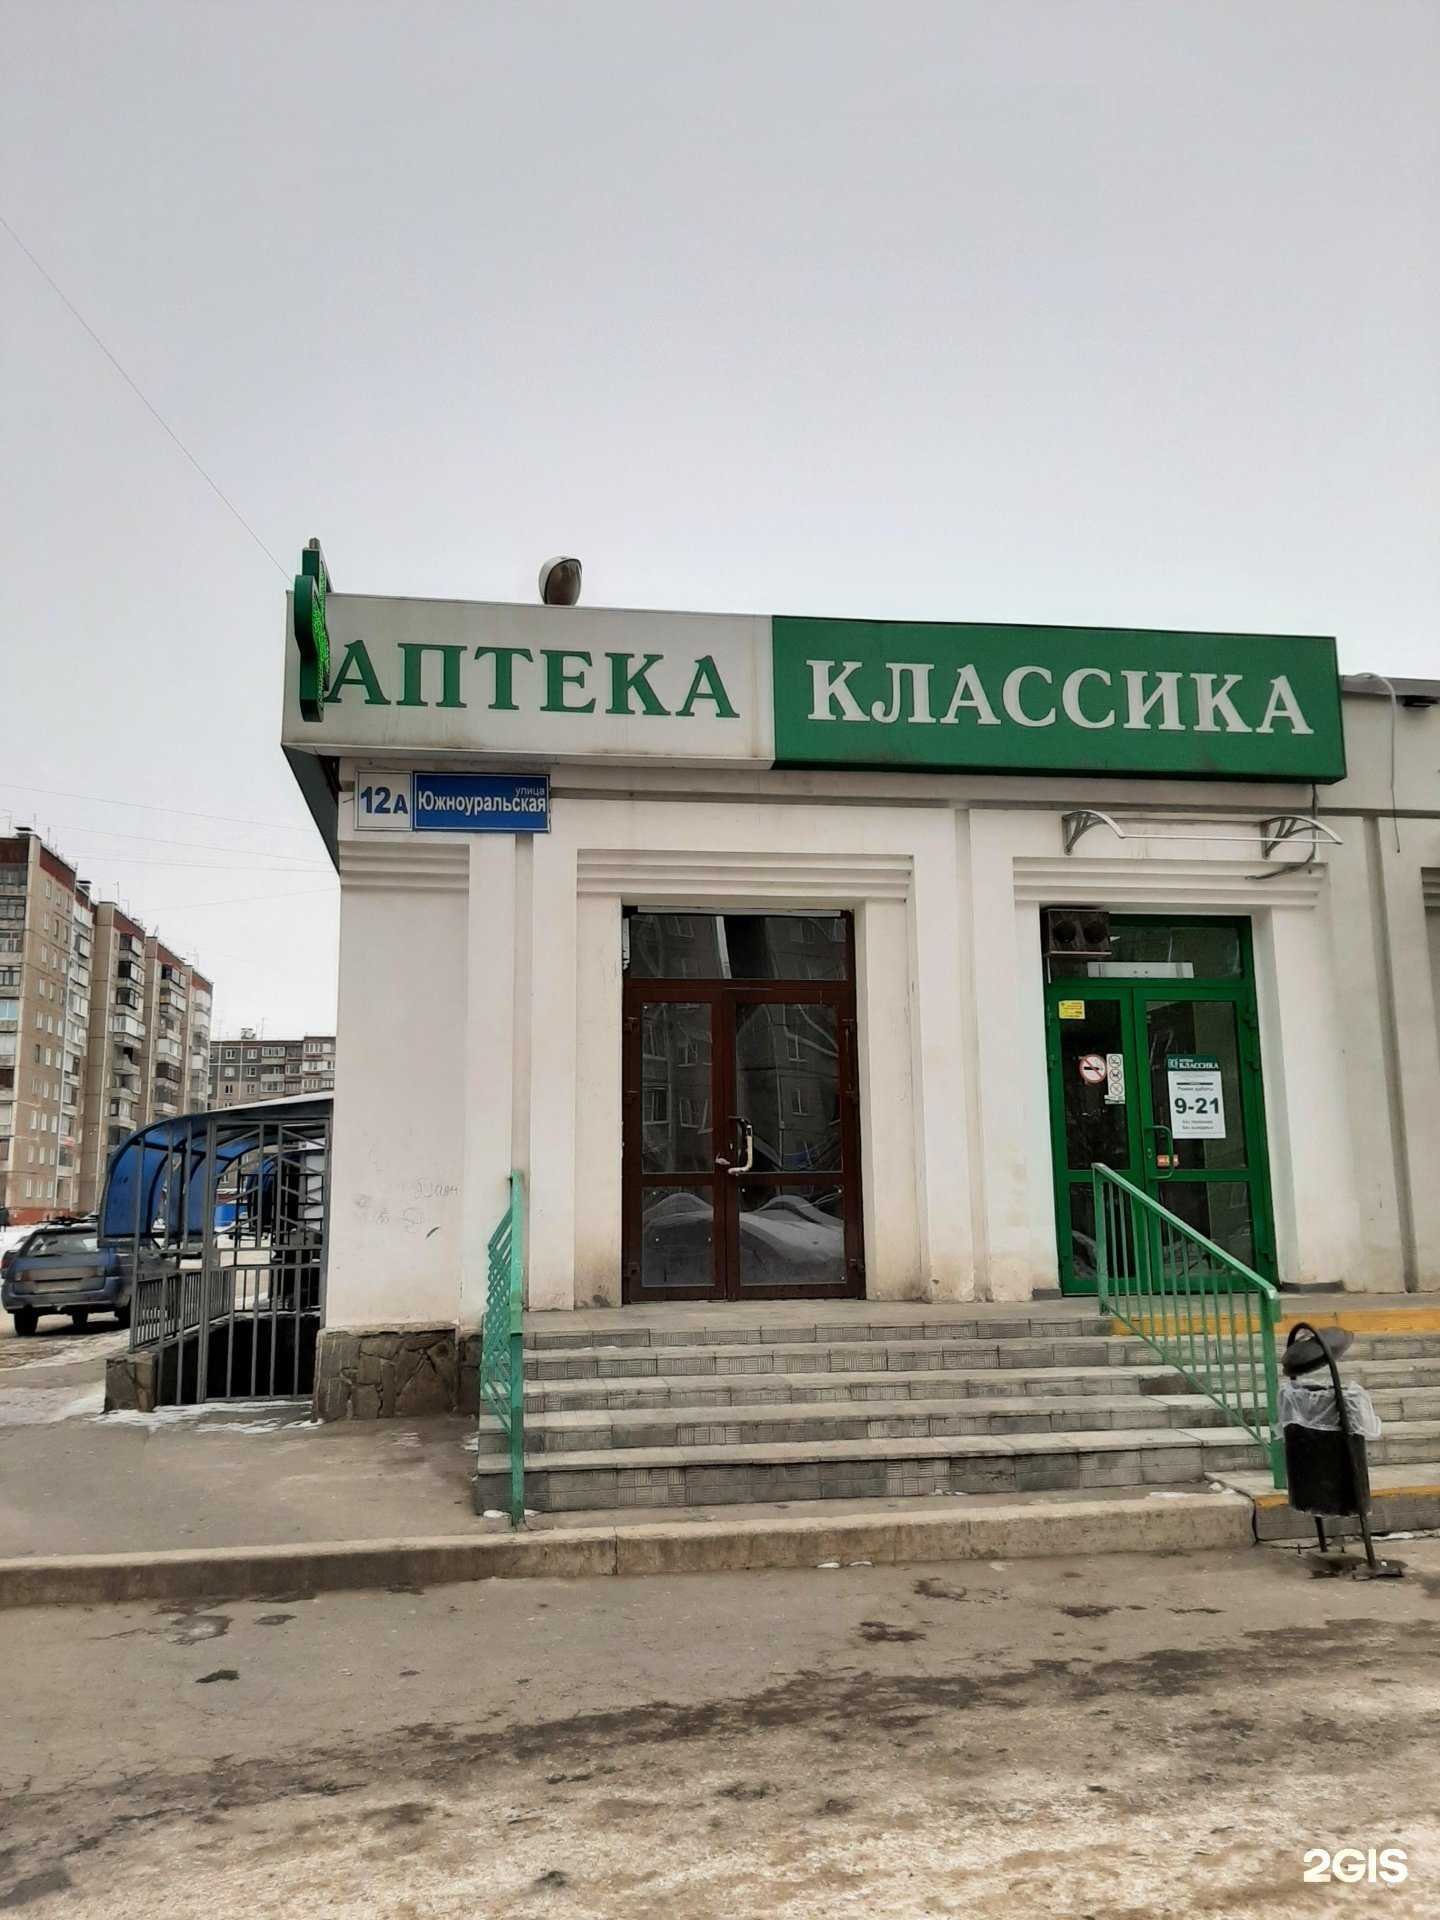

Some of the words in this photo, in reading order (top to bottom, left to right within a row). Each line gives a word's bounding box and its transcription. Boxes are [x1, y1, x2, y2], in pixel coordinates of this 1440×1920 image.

[325, 639, 741, 718] АПТЕКА
[806, 659, 1314, 734] КЛАССИКА
[360, 786, 409, 814] 12А
[418, 790, 546, 816] Южноуральская
[515, 786, 545, 797] улица
[1174, 1097, 1219, 1115] 9-21
